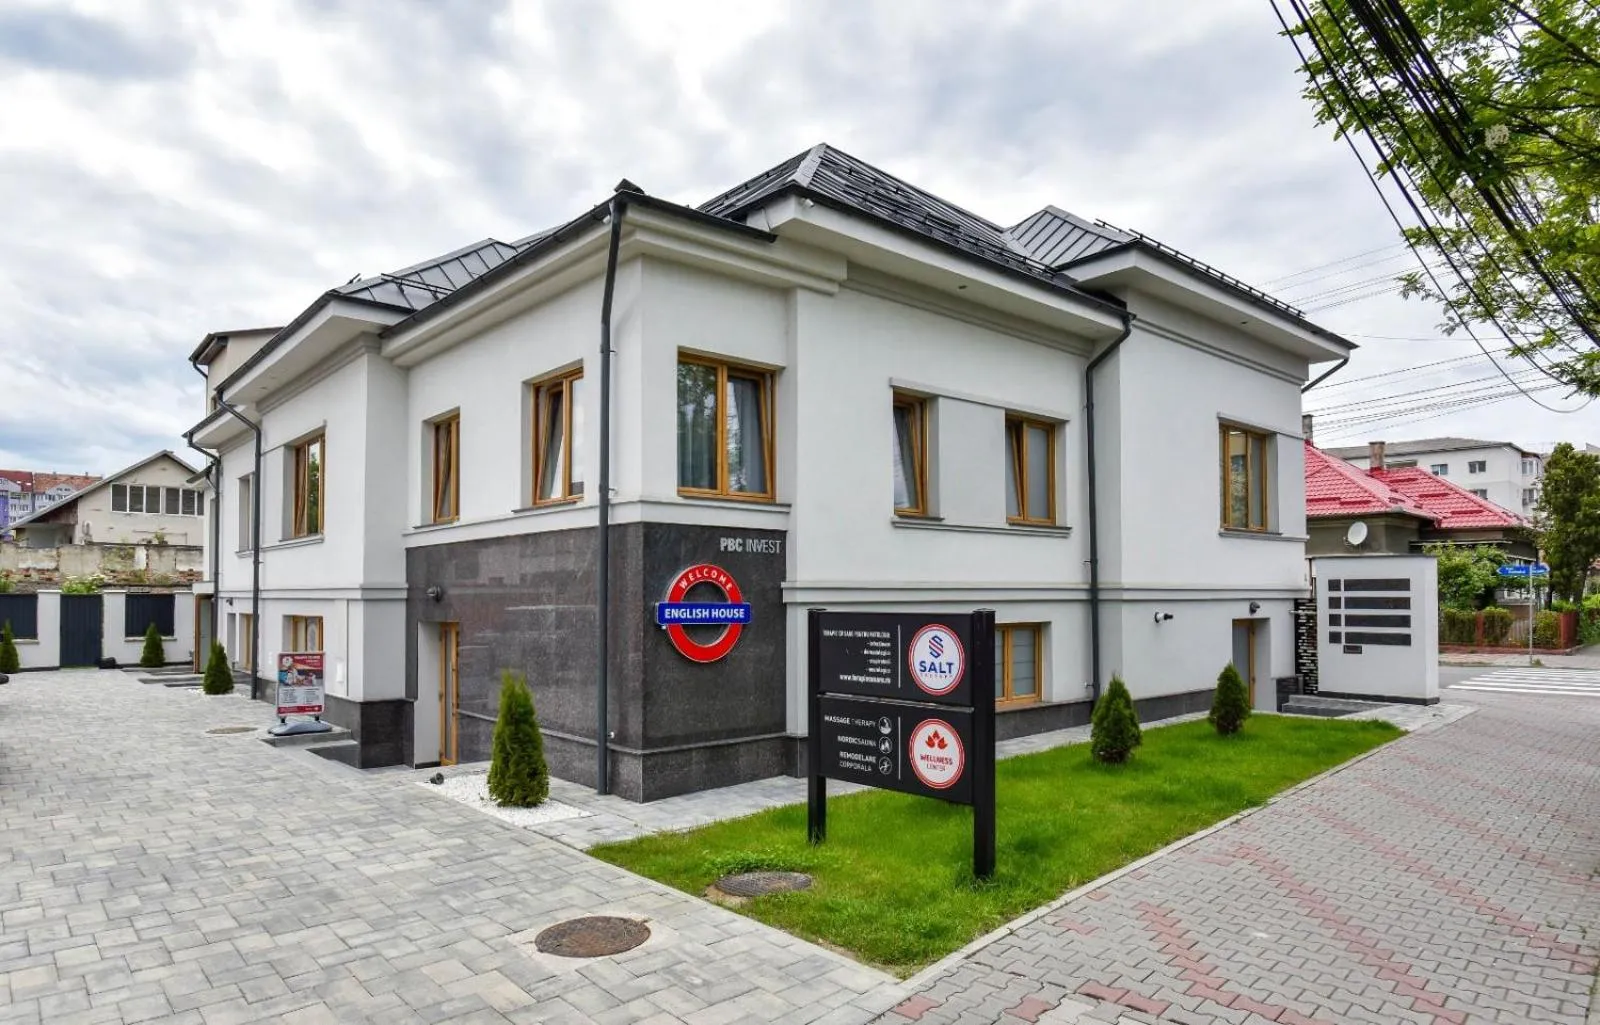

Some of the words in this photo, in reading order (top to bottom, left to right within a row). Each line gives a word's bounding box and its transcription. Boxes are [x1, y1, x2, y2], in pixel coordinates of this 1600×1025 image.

[720, 537, 743, 552] PBC
[746, 539, 782, 554] INVEST
[679, 568, 733, 591] WELCOME
[664, 608, 709, 619] ENGLISH
[711, 608, 745, 618] HOUSE
[919, 661, 954, 674] SALT
[824, 715, 850, 725] MASSAGE
[920, 753, 953, 765] WELLNESS
